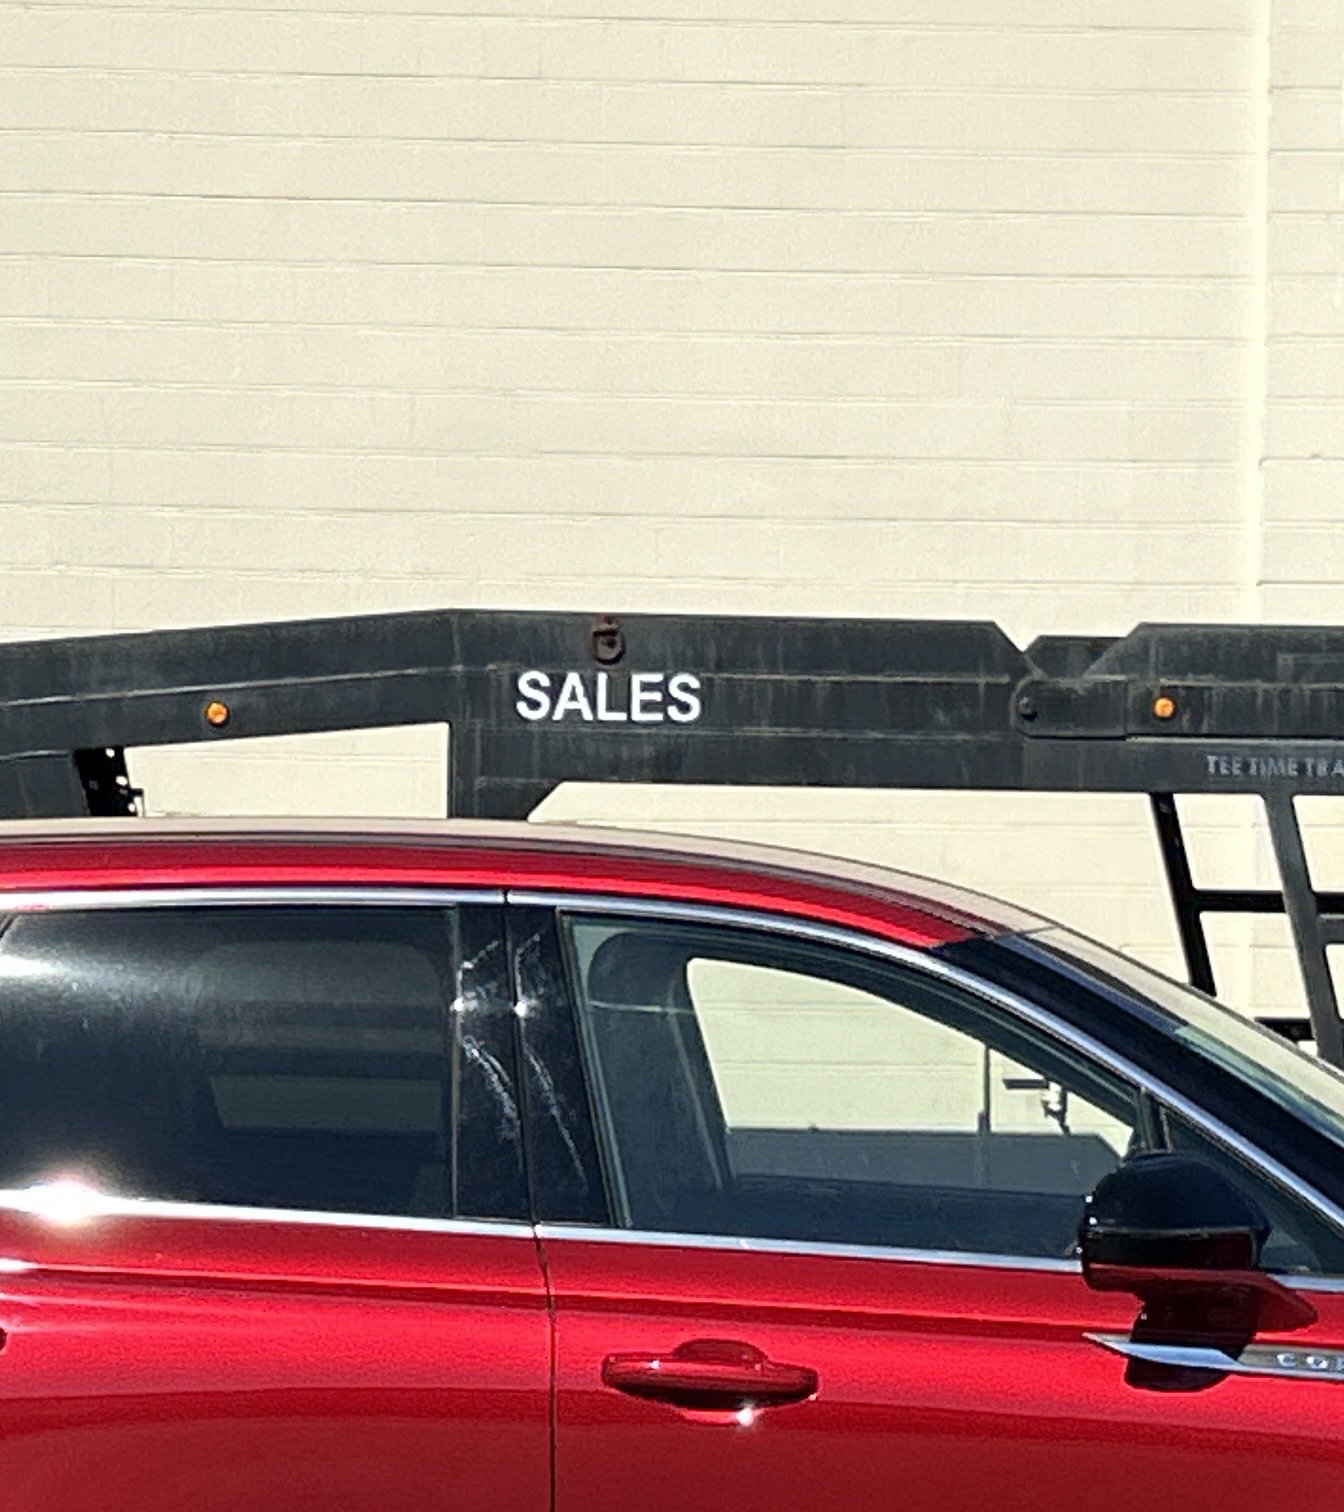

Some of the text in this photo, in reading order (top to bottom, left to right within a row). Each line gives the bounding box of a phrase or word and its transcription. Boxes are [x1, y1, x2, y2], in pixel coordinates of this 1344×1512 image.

[516, 670, 701, 722] SALES
[1206, 754, 1243, 777] TEE
[1246, 756, 1299, 779] TIME
